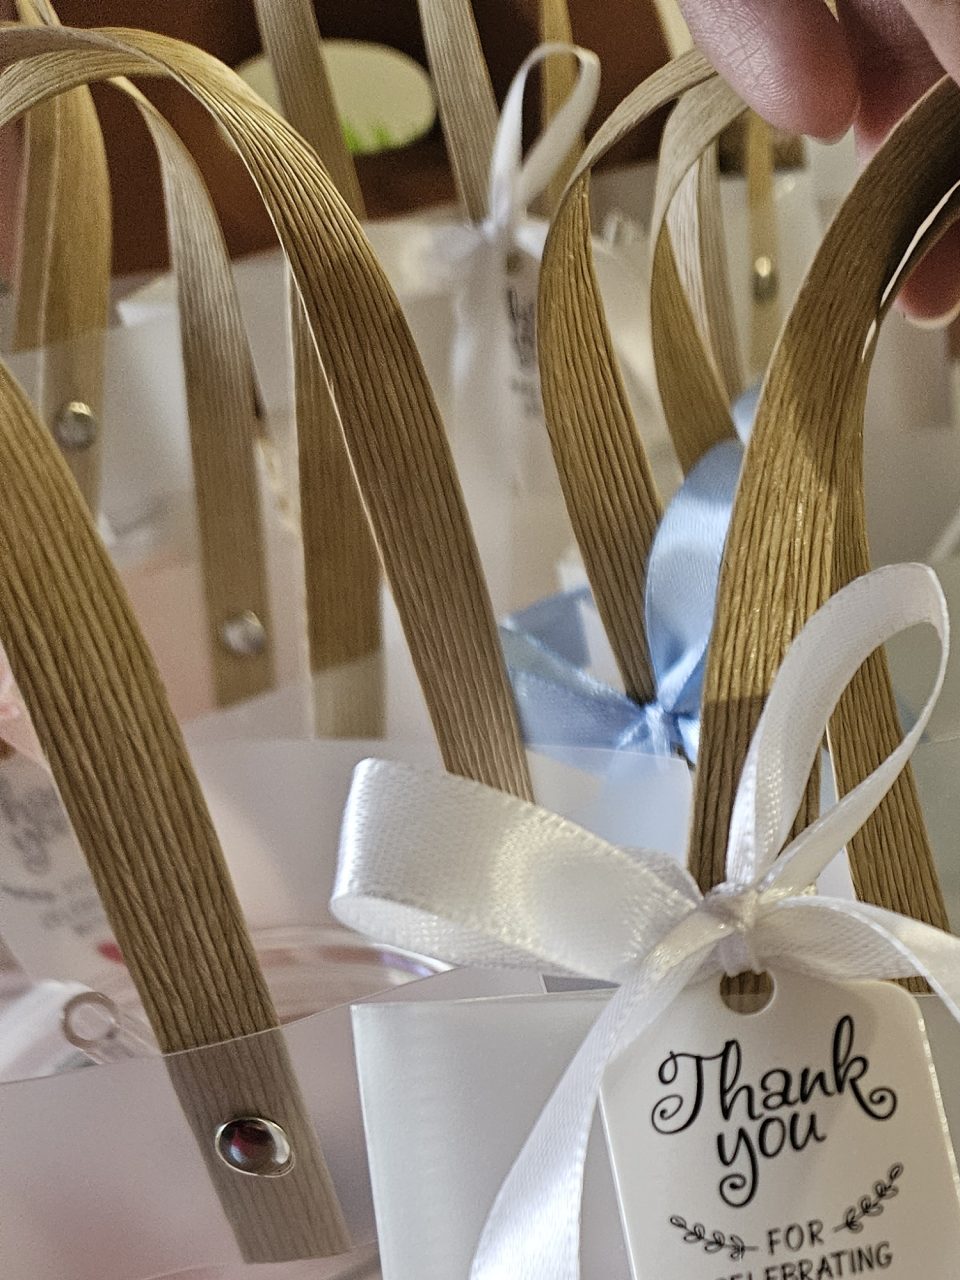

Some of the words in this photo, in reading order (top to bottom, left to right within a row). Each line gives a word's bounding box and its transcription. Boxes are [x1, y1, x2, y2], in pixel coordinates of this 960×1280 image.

[651, 1014, 897, 1134] Thank
[716, 1111, 826, 1208] you
[767, 1219, 825, 1256] FOR
